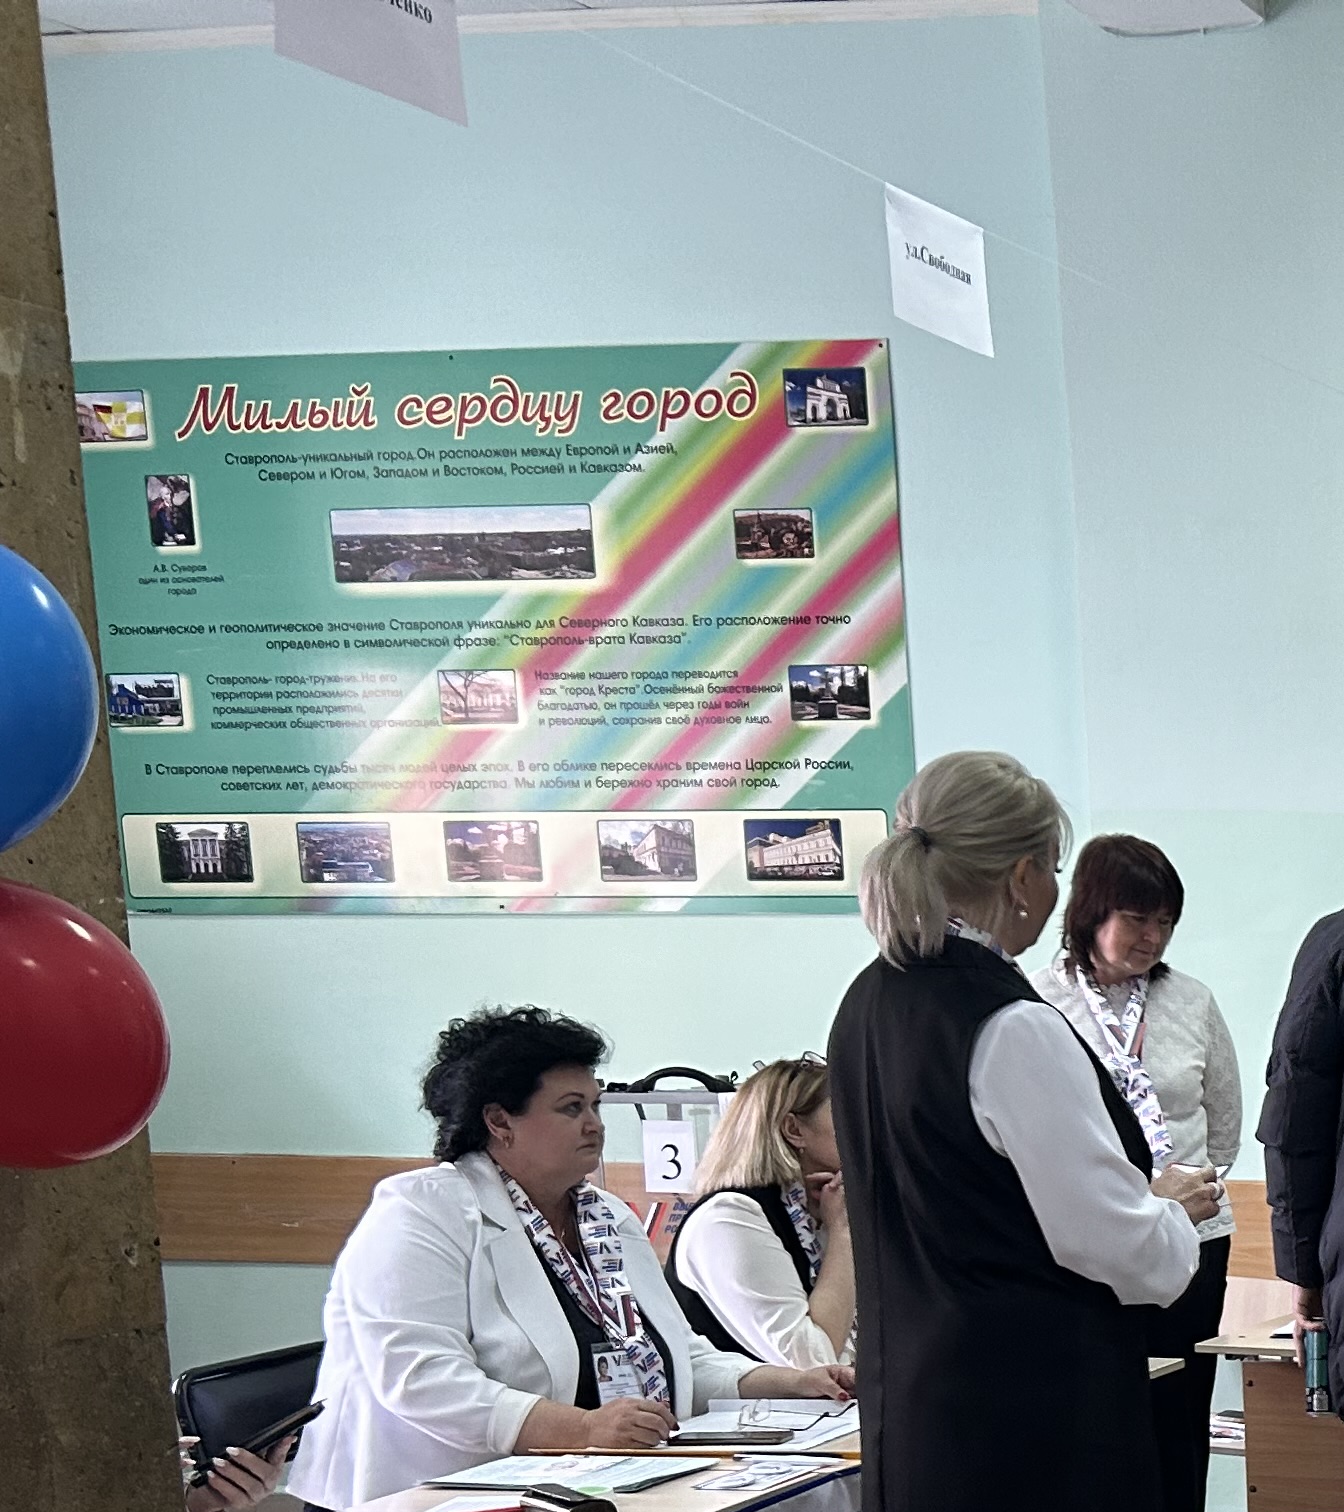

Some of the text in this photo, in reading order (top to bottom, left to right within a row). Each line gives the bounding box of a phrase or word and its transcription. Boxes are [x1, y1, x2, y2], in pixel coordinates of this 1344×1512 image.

[175, 370, 760, 442] Милый сердцу город
[439, 447, 518, 463] расположен
[521, 446, 561, 461] между
[565, 442, 618, 461] Европой
[623, 444, 631, 455] и
[635, 441, 678, 456] Азией,
[258, 468, 316, 485] Севером
[319, 469, 327, 480] и
[330, 466, 370, 481] Югом,
[373, 465, 428, 480] Западом
[432, 467, 440, 477] и
[443, 463, 507, 477] Востоком,
[511, 462, 565, 475] Россией
[568, 463, 577, 474] и
[108, 613, 851, 636] Экономическое и геополитическое значение Ставрополя уникально для Северного Кавказа. Его расположение точно
[266, 639, 340, 652] определено
[344, 638, 351, 648] в
[354, 635, 450, 649] символической
[535, 669, 739, 682] Название нашего города переводится
[707, 681, 784, 694] божественной
[604, 701, 617, 710] он
[663, 700, 695, 712] через
[724, 698, 750, 709] войн
[144, 763, 153, 775] В
[155, 762, 229, 777] Ставрополе
[232, 762, 311, 777] переплелись
[313, 759, 358, 776] судьбы
[517, 760, 525, 772] В
[528, 761, 551, 773] его
[553, 760, 597, 772] облике
[600, 758, 683, 774] пересеклись
[685, 759, 742, 773] времена
[745, 756, 801, 772] Царской
[804, 756, 854, 771] России,
[220, 780, 283, 792] советских
[584, 777, 592, 788] и
[595, 774, 653, 791] бережно
[656, 775, 703, 791] храним
[707, 773, 737, 788] свой
[740, 776, 781, 789] город.
[660, 1143, 683, 1181] 3
